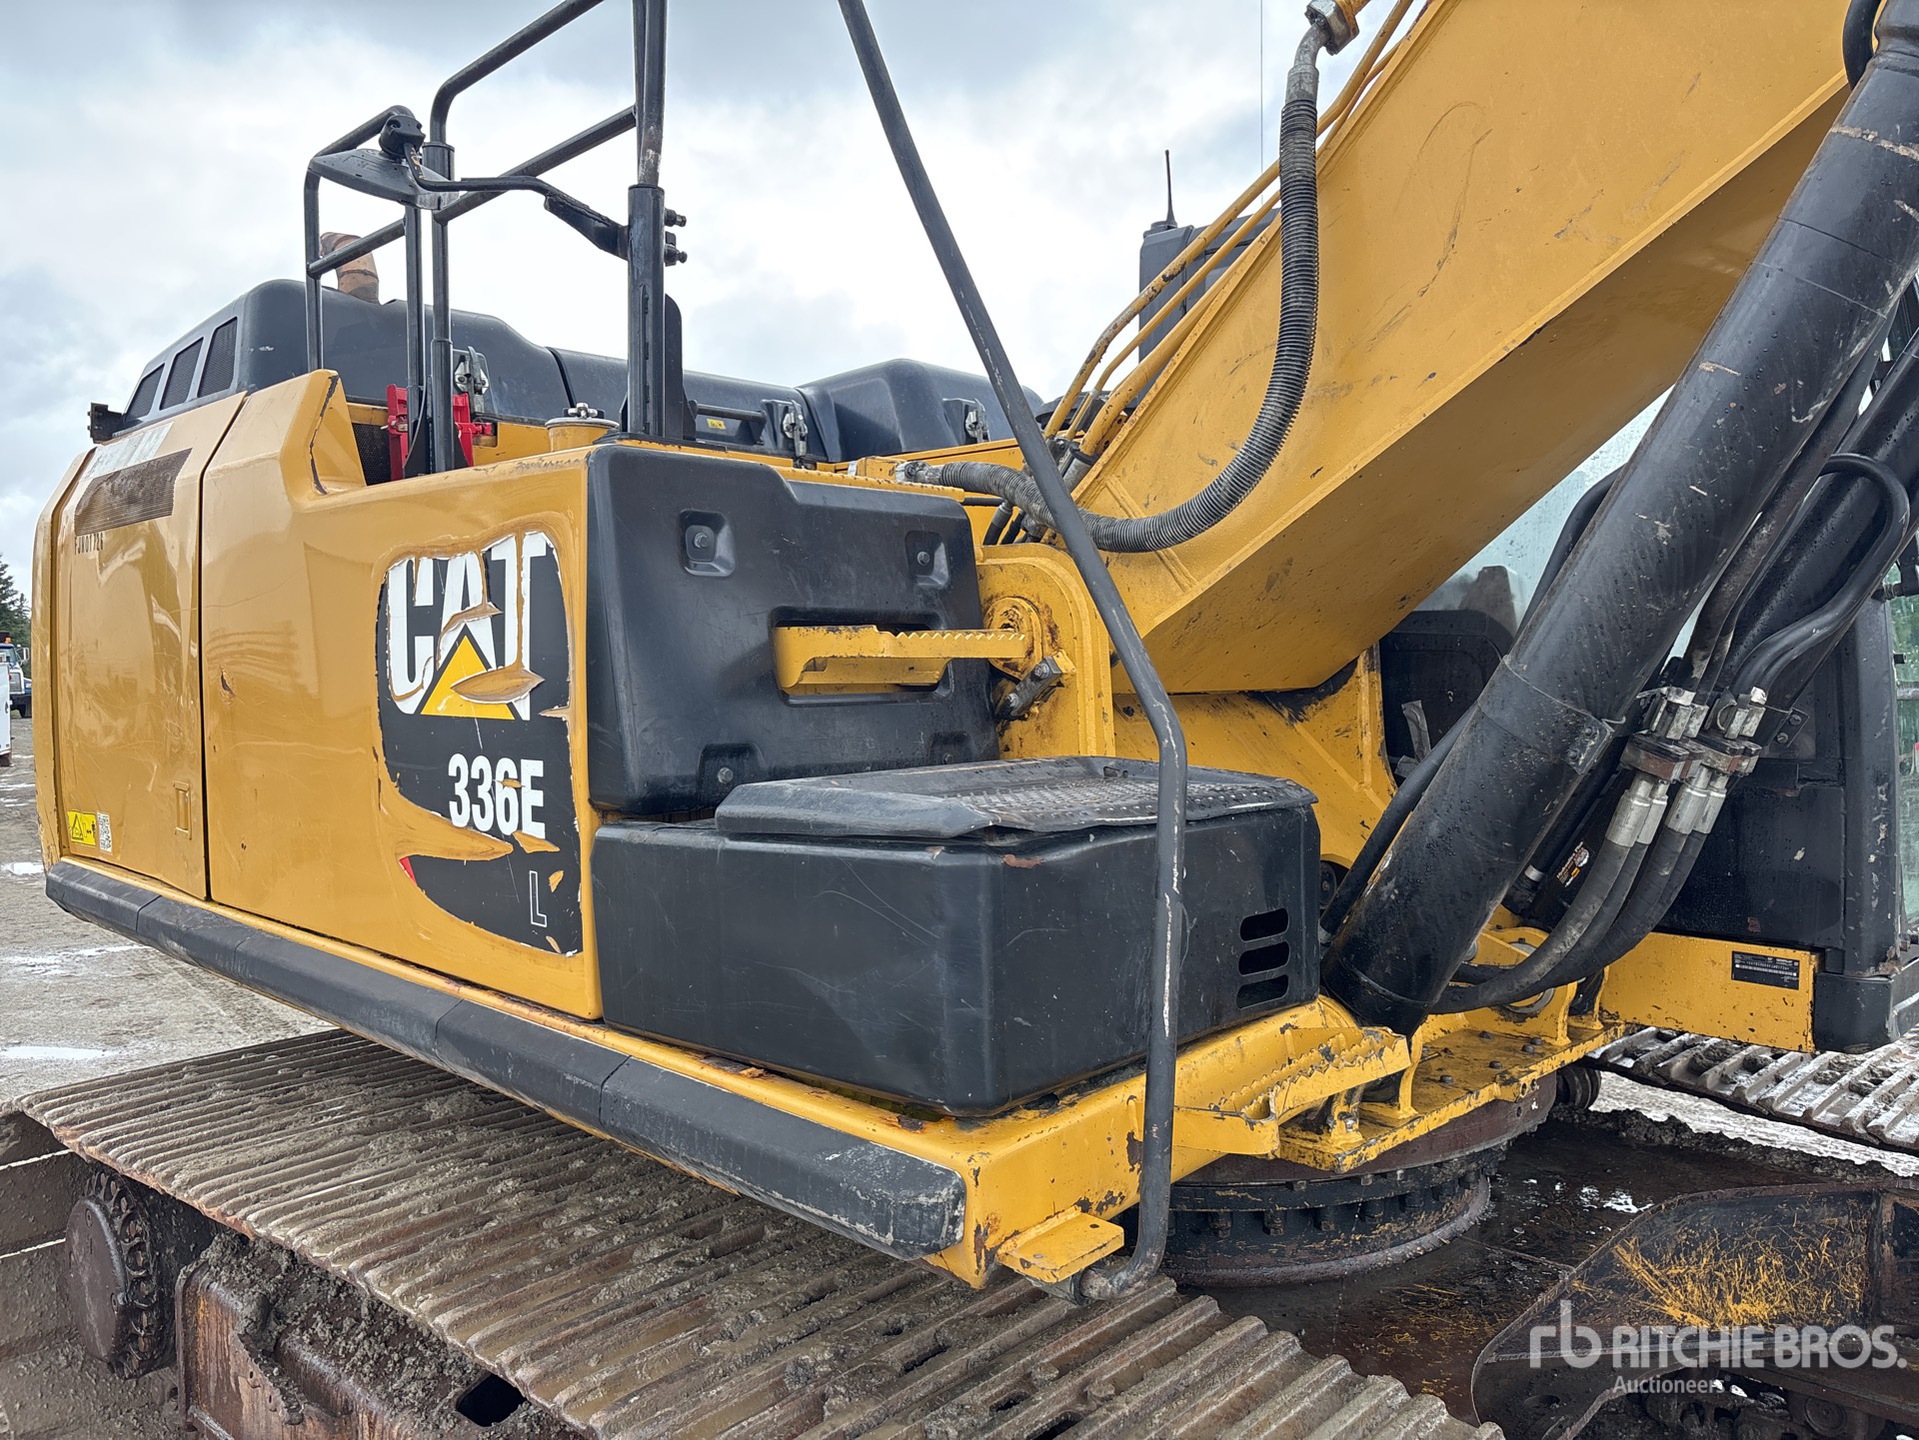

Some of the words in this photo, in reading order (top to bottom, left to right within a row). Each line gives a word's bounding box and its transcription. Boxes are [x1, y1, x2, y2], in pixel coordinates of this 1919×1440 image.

[387, 533, 547, 720] CAT
[448, 753, 546, 839] 336E
[528, 870, 547, 928] L
